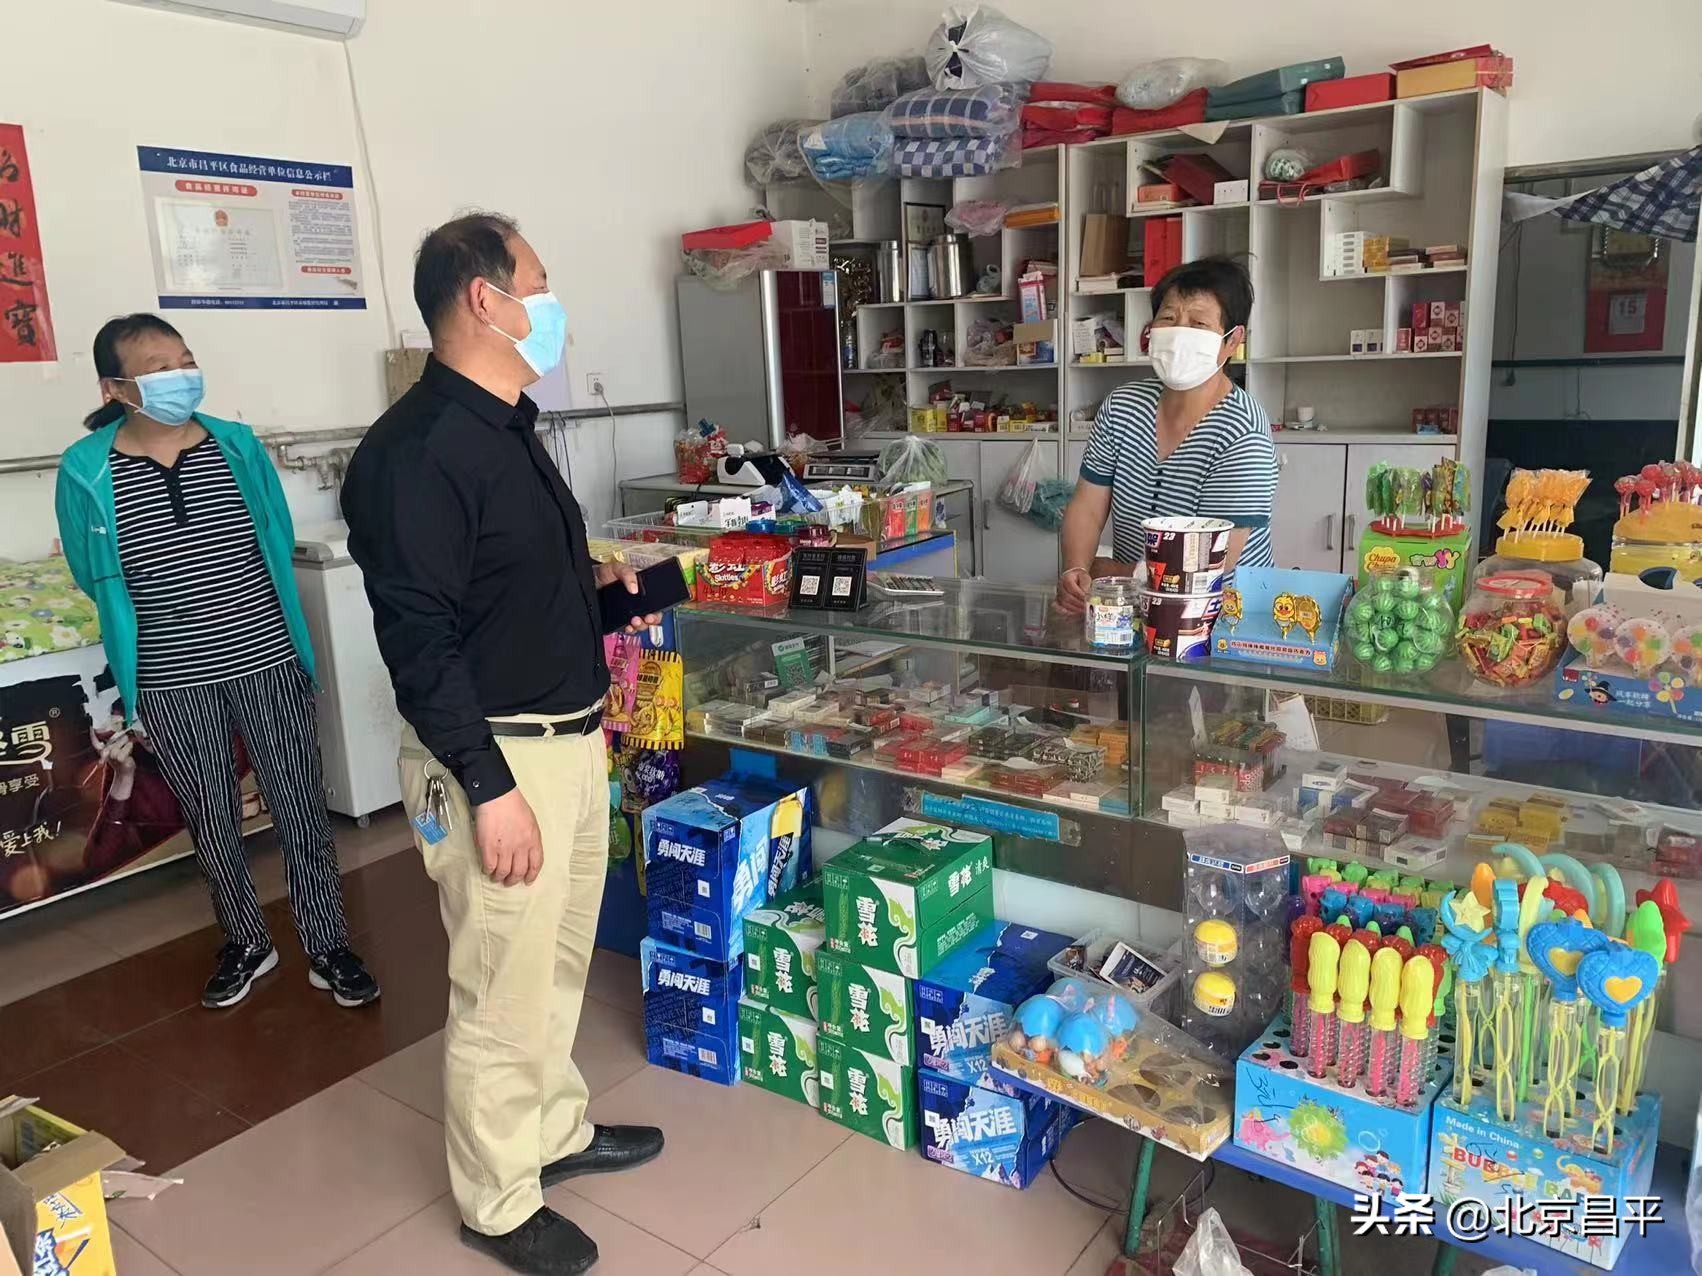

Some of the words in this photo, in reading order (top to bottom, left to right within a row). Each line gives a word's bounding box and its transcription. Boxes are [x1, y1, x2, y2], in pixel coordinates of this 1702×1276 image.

[166, 155, 332, 182] 北京市昌平区食品经营单位信息公示栏
[657, 838, 706, 867] 勇闯天涯
[855, 896, 879, 948] 雪花
[658, 968, 711, 996] 勇闯天涯
[772, 947, 794, 994] 雪花
[848, 982, 871, 1033] 雪花
[767, 1030, 788, 1078] 雪花
[929, 1012, 1008, 1061] 勇闯天涯
[847, 1066, 869, 1116] 雪花
[933, 1105, 1016, 1152] 勇闯天涯
[1445, 1115, 1475, 1133] Made
[1477, 1127, 1487, 1137] in
[1489, 1131, 1520, 1149] China
